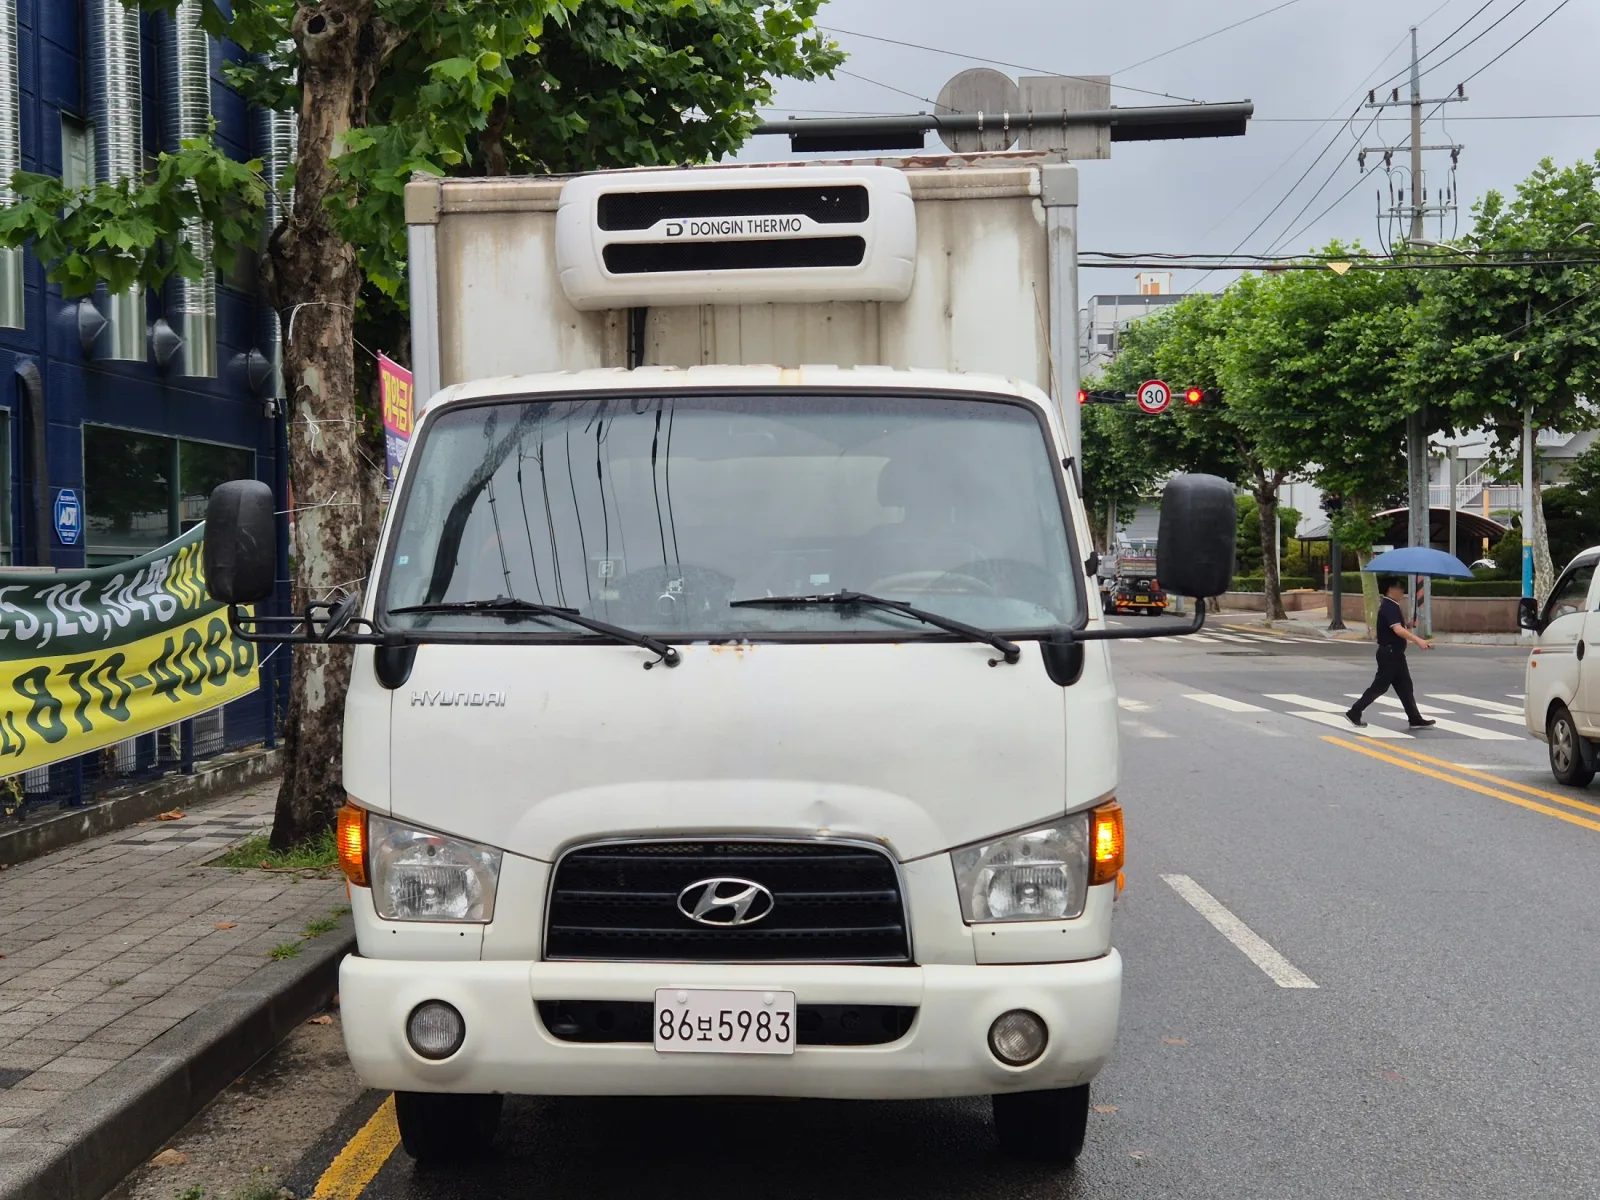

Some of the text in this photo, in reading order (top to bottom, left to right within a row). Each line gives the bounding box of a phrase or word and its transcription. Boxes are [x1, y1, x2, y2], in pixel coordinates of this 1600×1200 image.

[691, 220, 743, 236] DONGIN
[748, 218, 802, 233] THERMO
[1145, 389, 1164, 404] 30
[60, 507, 77, 526] ADT
[0, 555, 177, 649] 5,29,34평
[411, 691, 506, 707] HYUNDAI
[659, 1008, 790, 1043] 86보5983
